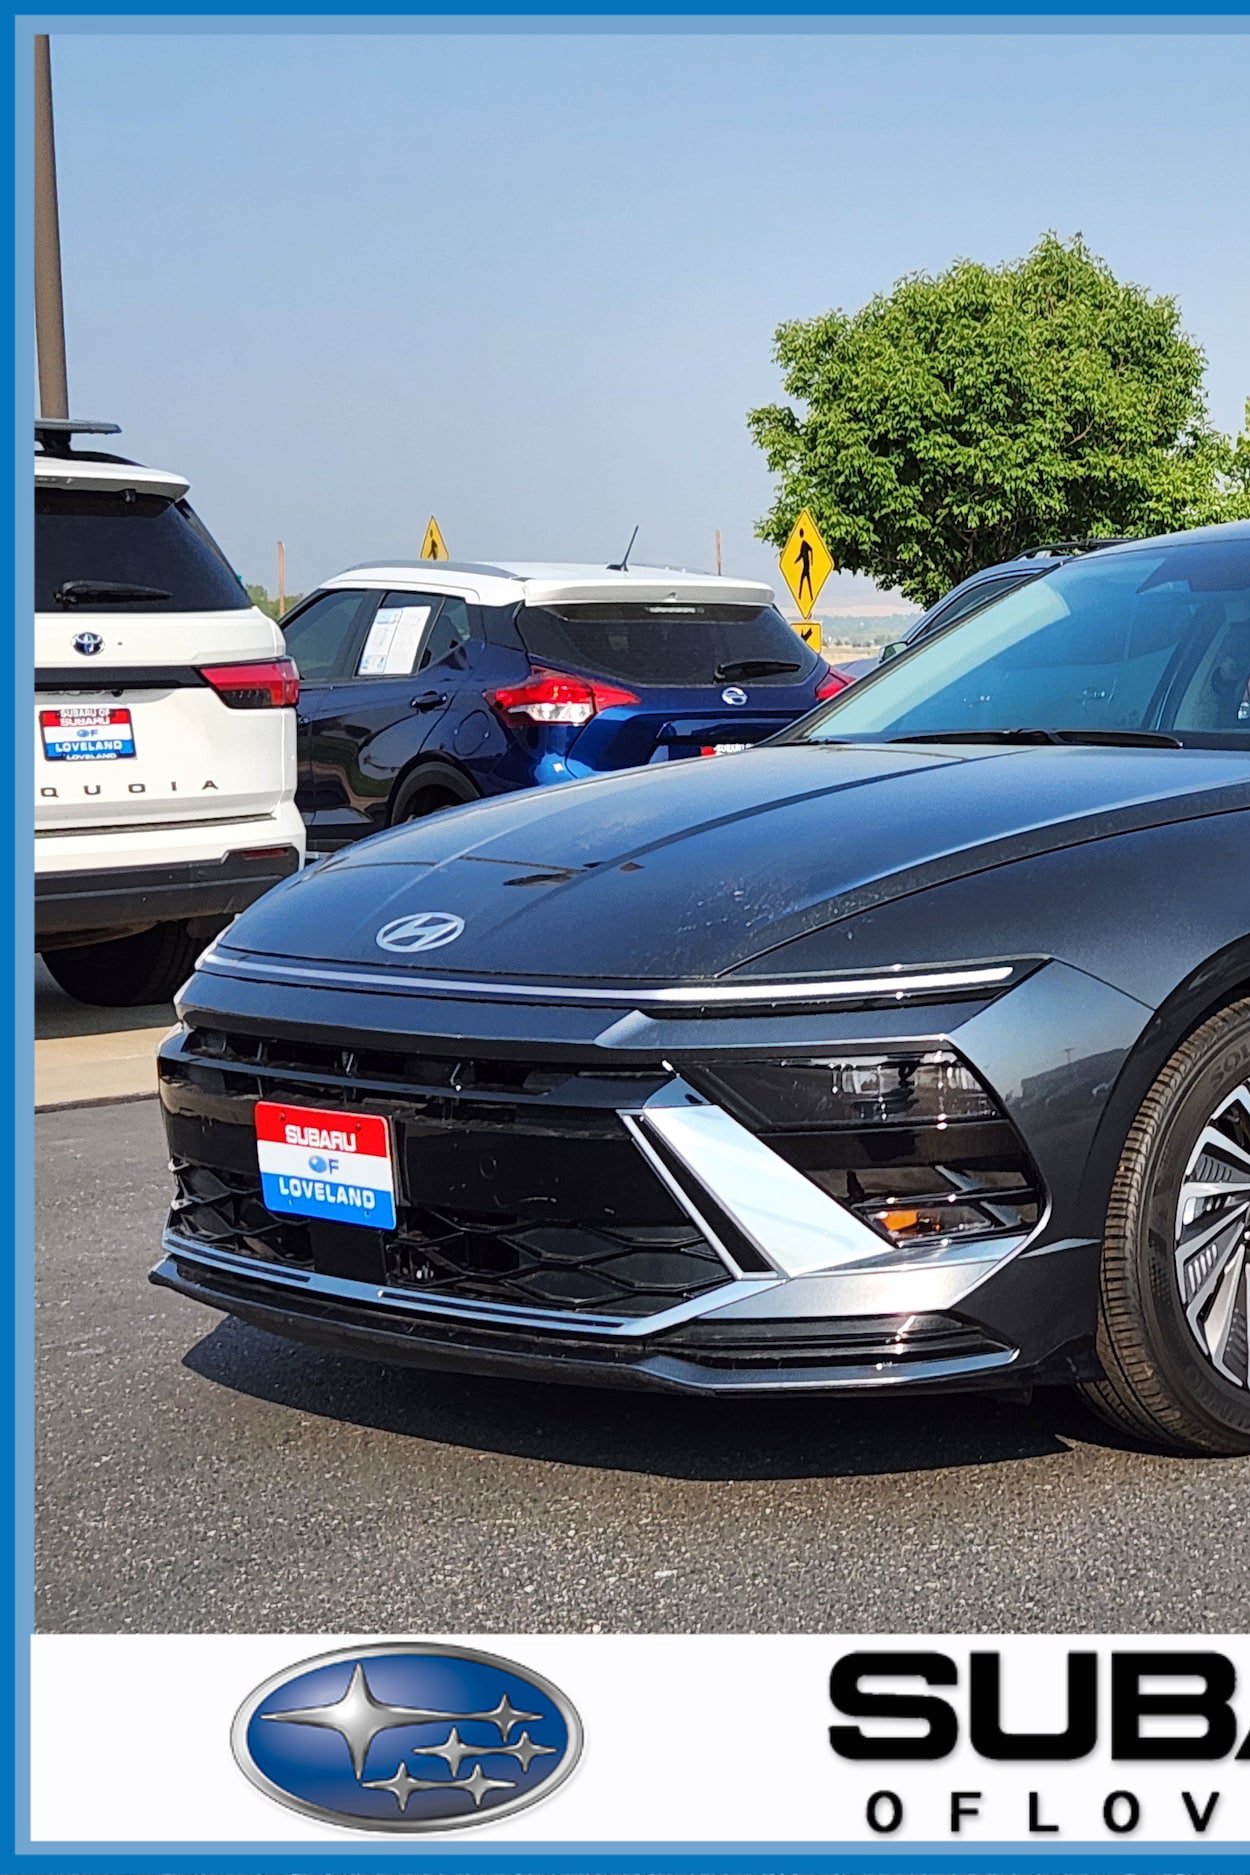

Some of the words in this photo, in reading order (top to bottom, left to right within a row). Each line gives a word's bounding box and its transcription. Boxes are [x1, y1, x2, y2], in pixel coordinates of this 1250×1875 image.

[55, 740, 123, 753] LOVELAND
[284, 1124, 357, 1152] SUBARU
[279, 1176, 376, 1210] LOVELAND
